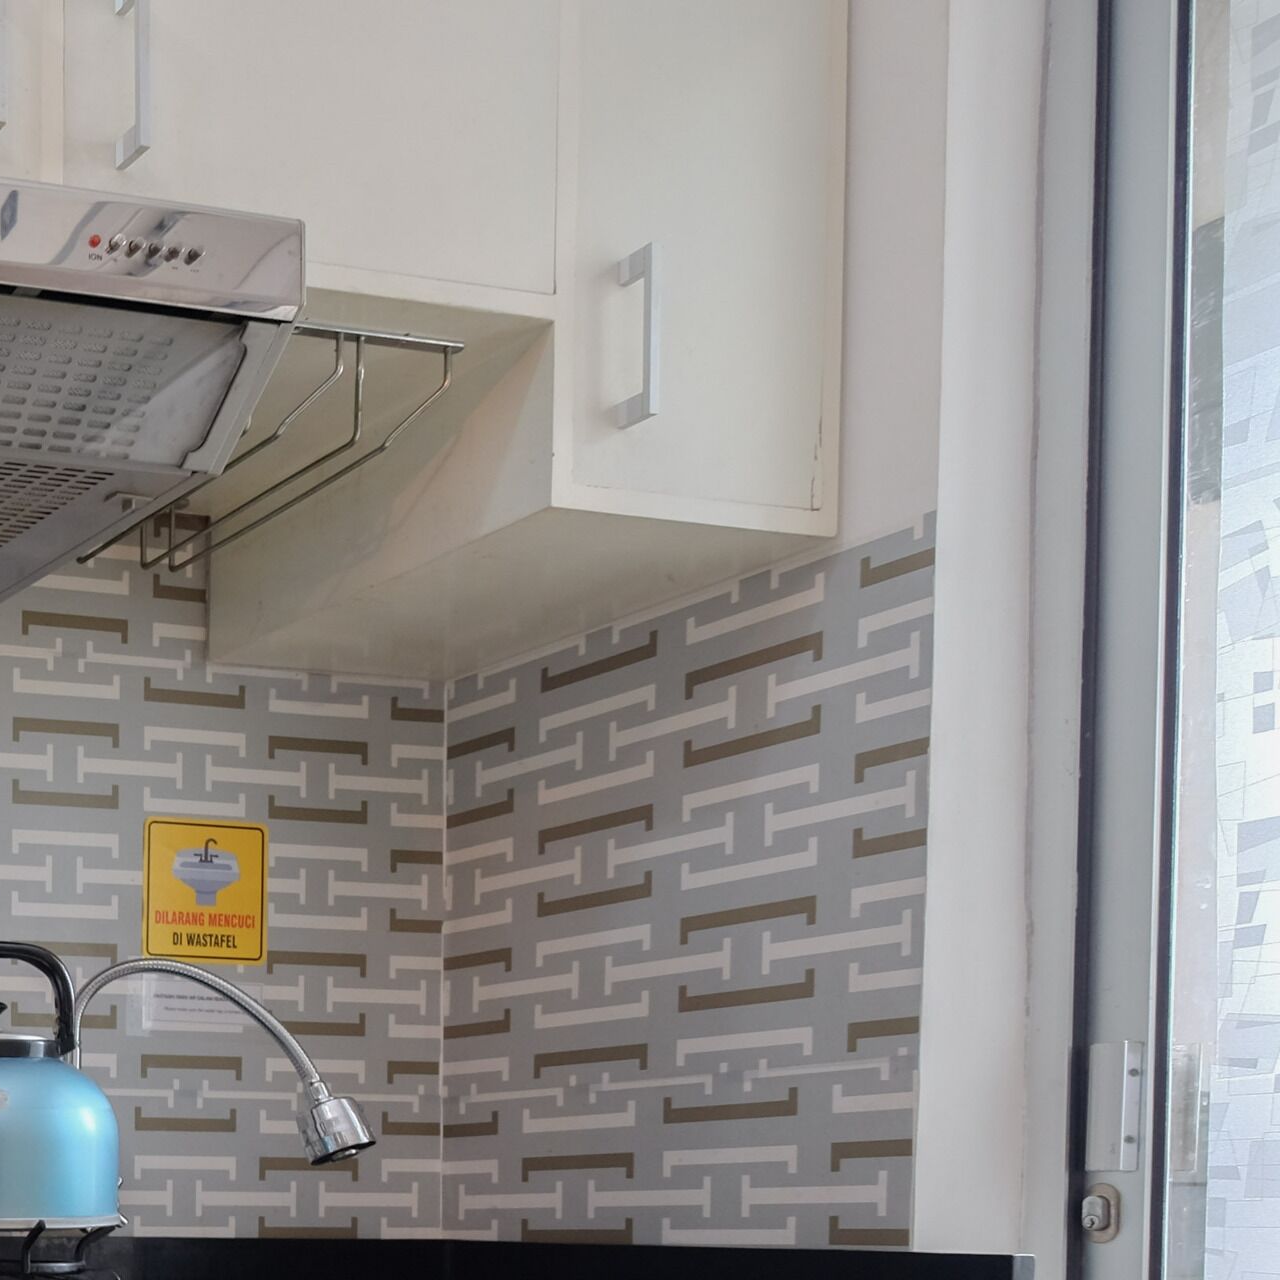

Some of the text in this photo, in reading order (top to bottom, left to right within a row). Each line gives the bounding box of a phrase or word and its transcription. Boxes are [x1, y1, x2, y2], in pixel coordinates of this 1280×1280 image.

[154, 910, 256, 929] DILARANG MENCUCI
[172, 932, 238, 949] DI WASTAFEL
